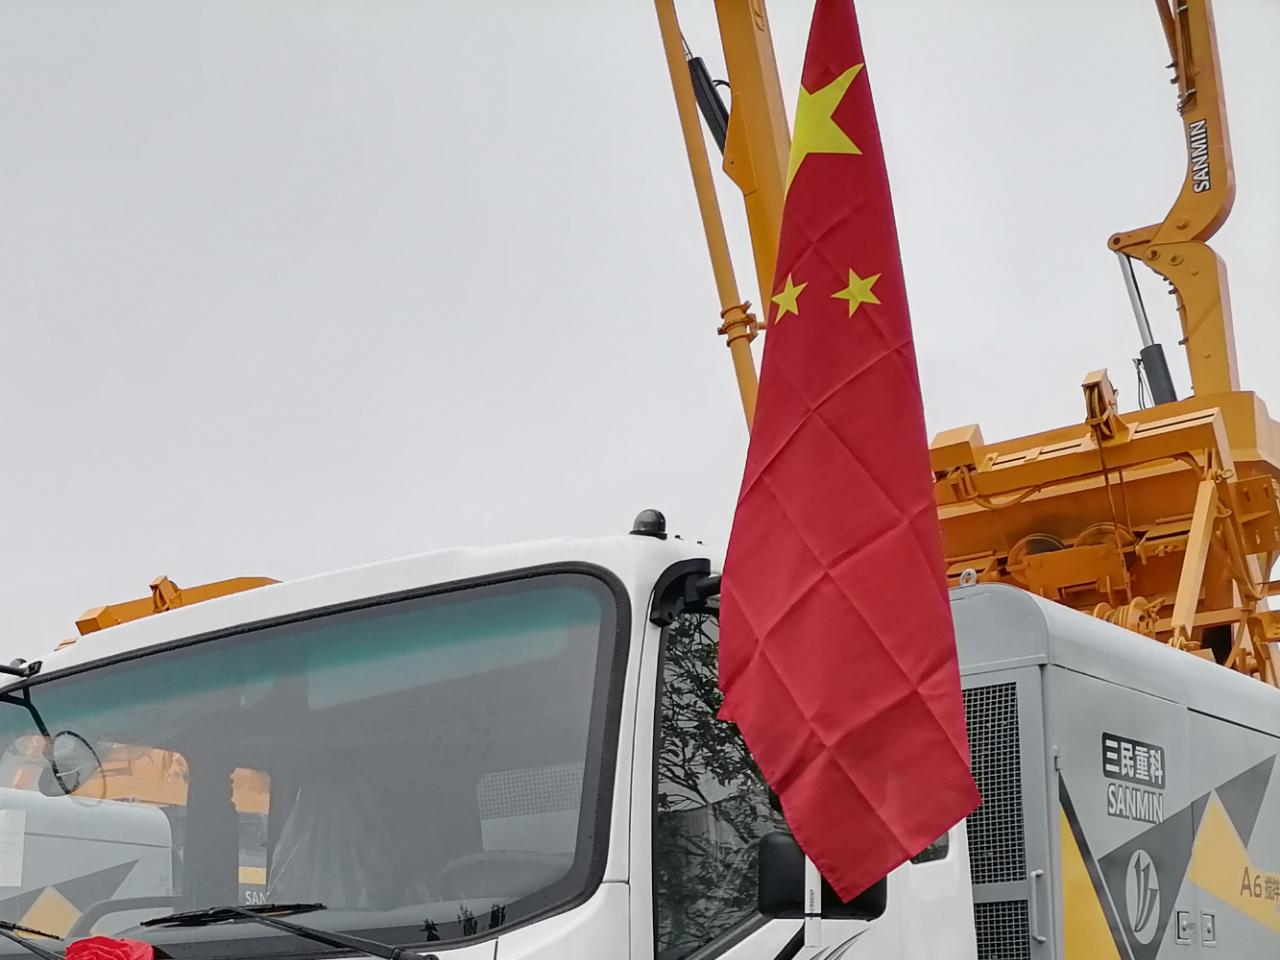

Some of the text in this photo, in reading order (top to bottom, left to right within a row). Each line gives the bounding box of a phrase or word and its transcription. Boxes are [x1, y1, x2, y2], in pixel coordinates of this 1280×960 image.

[1189, 119, 1210, 193] SANMIN
[1105, 738, 1163, 785] 三民重科
[1108, 783, 1163, 824] SANMIN
